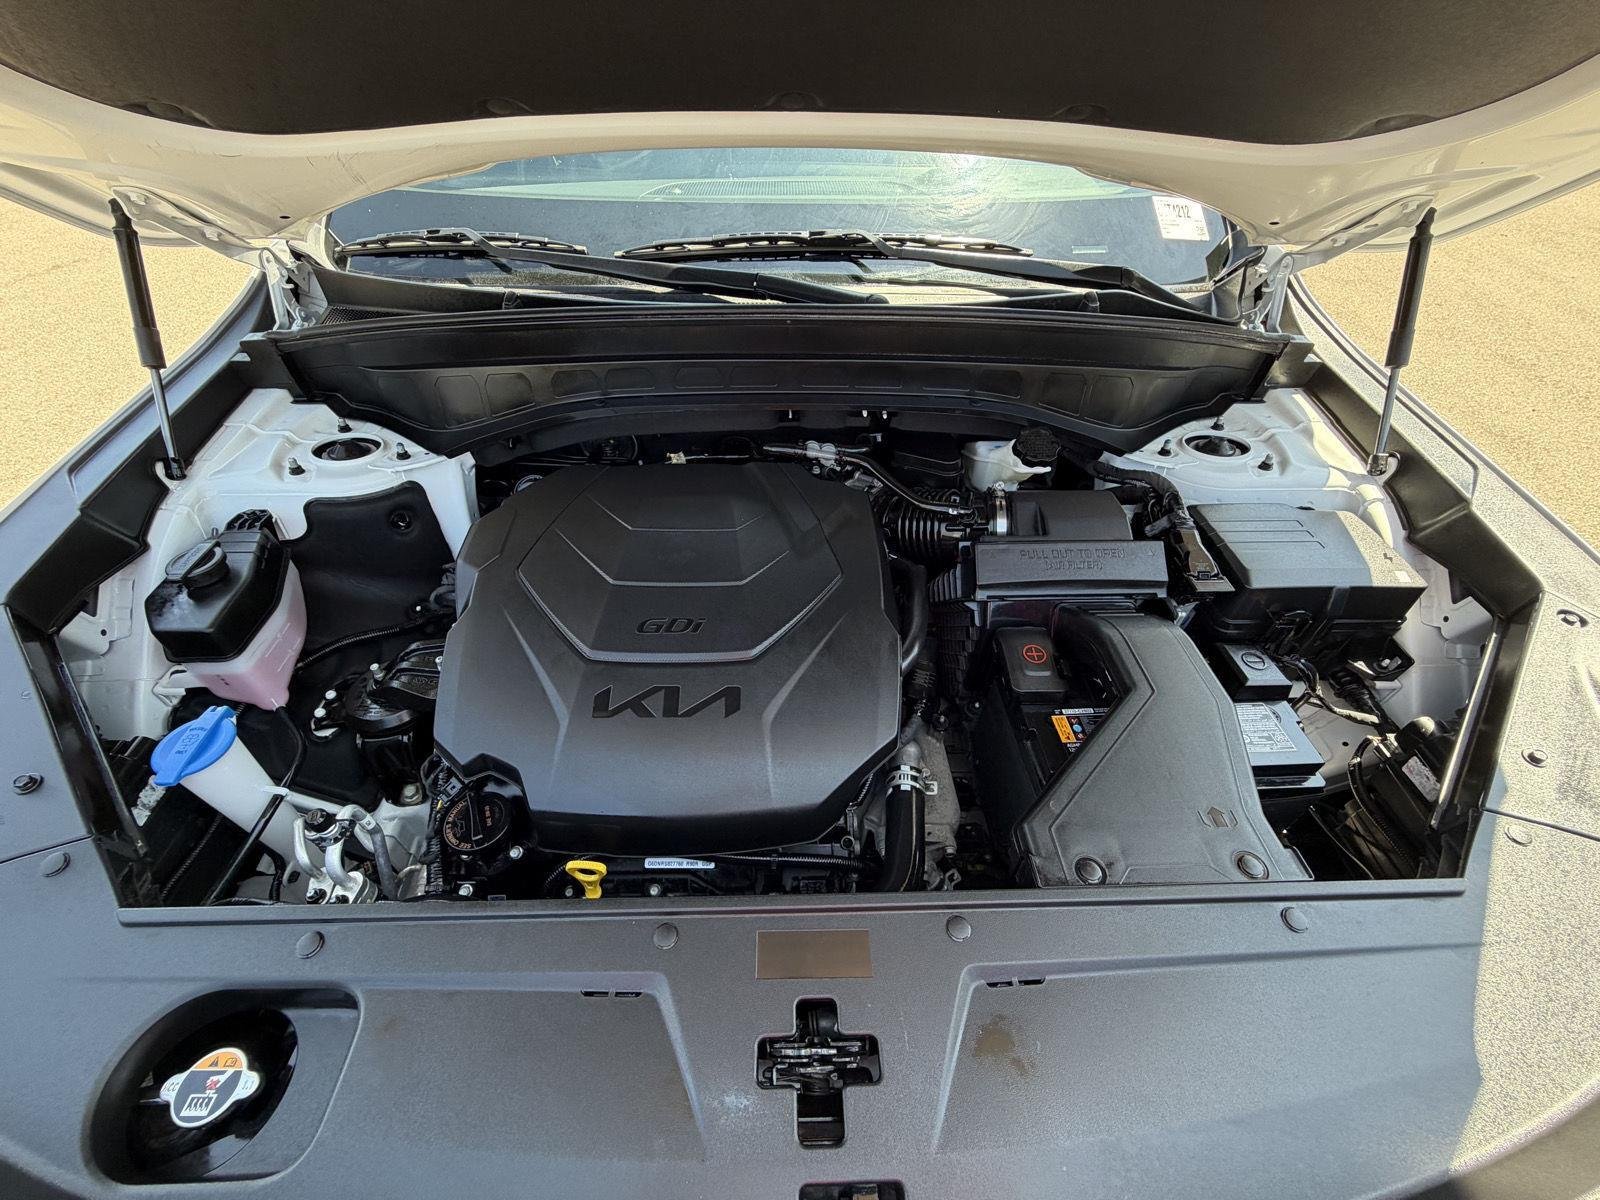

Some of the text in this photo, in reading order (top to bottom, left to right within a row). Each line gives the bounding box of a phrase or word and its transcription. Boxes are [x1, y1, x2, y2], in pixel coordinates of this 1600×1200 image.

[1020, 548, 1125, 559] PULL OUT TO OPEN
[635, 617, 707, 635] GDi
[592, 684, 742, 718] KIA
